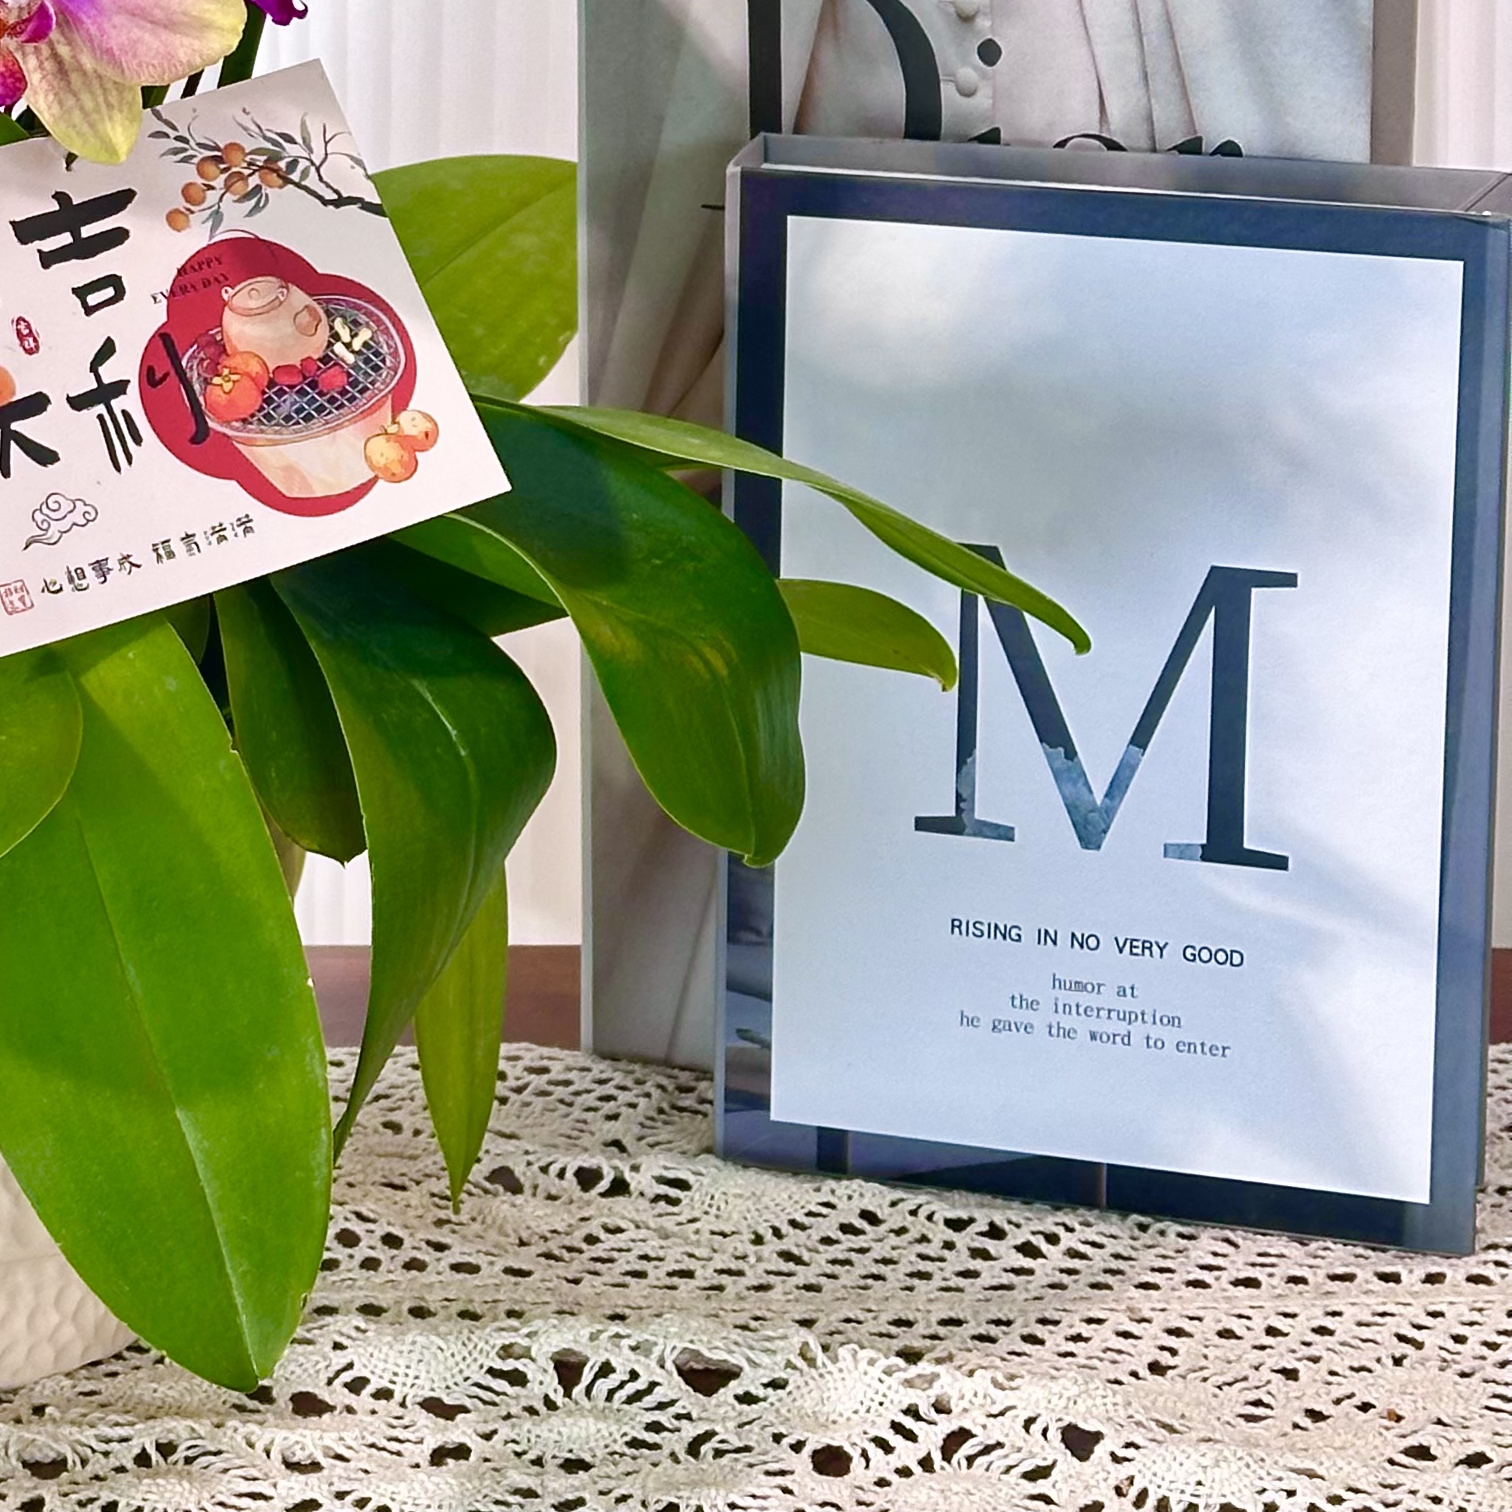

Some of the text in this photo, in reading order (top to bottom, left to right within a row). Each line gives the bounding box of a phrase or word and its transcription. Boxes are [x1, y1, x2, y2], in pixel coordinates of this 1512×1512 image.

[176, 253, 223, 277] HAPPY
[41, 552, 143, 594] 心想事成
[914, 541, 1298, 872] M
[950, 918, 1245, 967] RISING IN NO VERY GOOD
[1052, 973, 1138, 999] humor at
[1009, 993, 1182, 1029] the interruption
[959, 1010, 1231, 1059] he gave the word to enter
